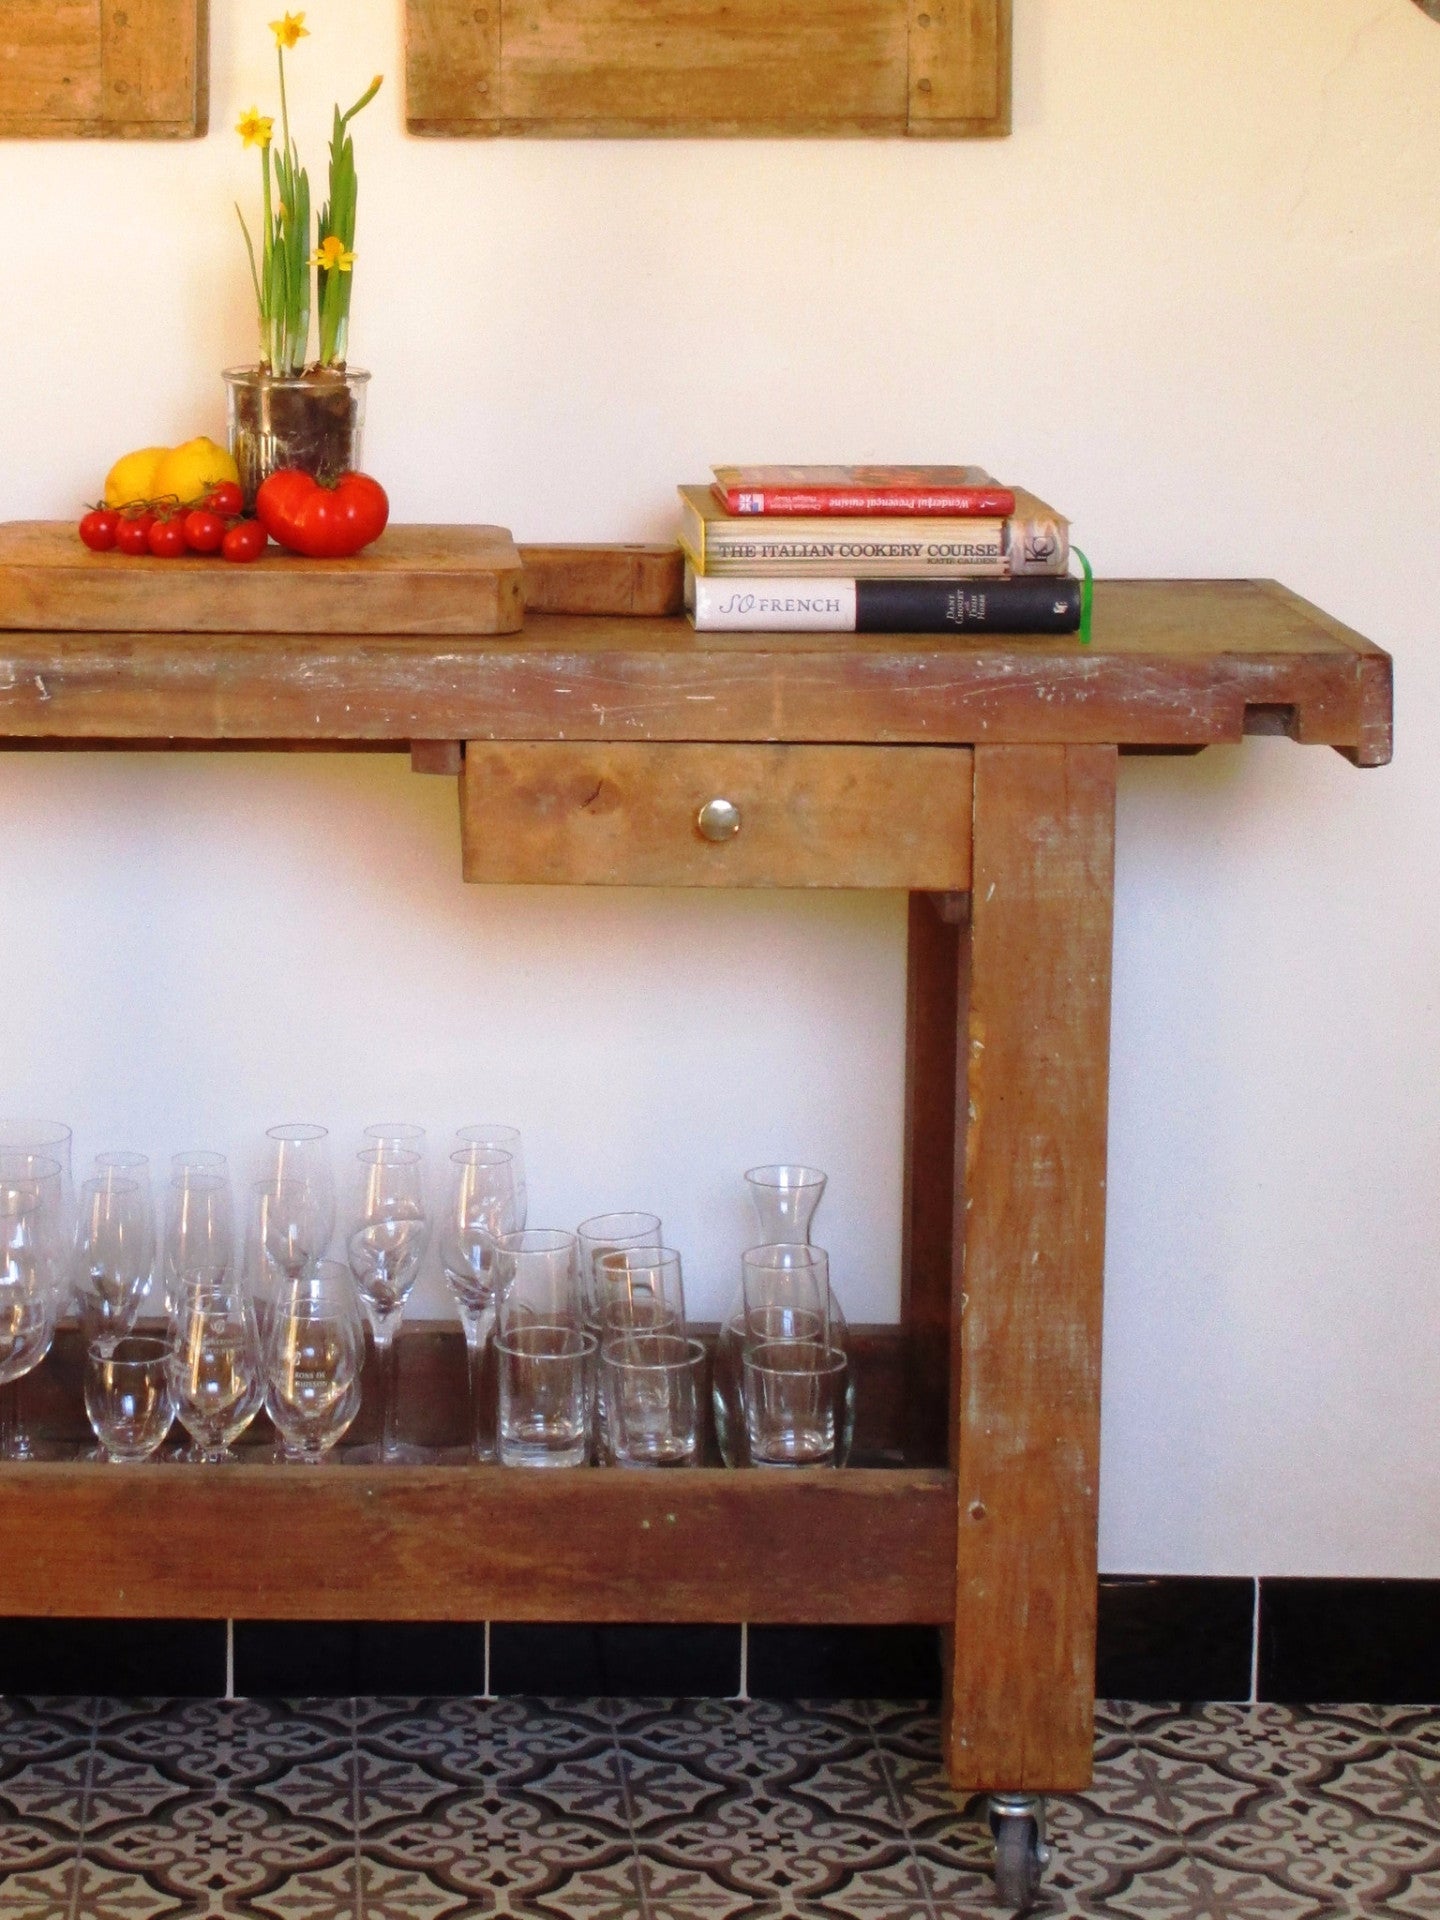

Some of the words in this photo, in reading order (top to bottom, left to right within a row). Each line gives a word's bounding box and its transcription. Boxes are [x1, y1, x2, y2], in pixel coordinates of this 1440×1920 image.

[918, 495, 969, 509] Wonderful
[719, 545, 756, 557] THE
[761, 545, 834, 557] ITALIAN
[839, 544, 922, 557] COOKERY
[927, 544, 997, 557] COURSE
[759, 599, 840, 612] FRENCH
